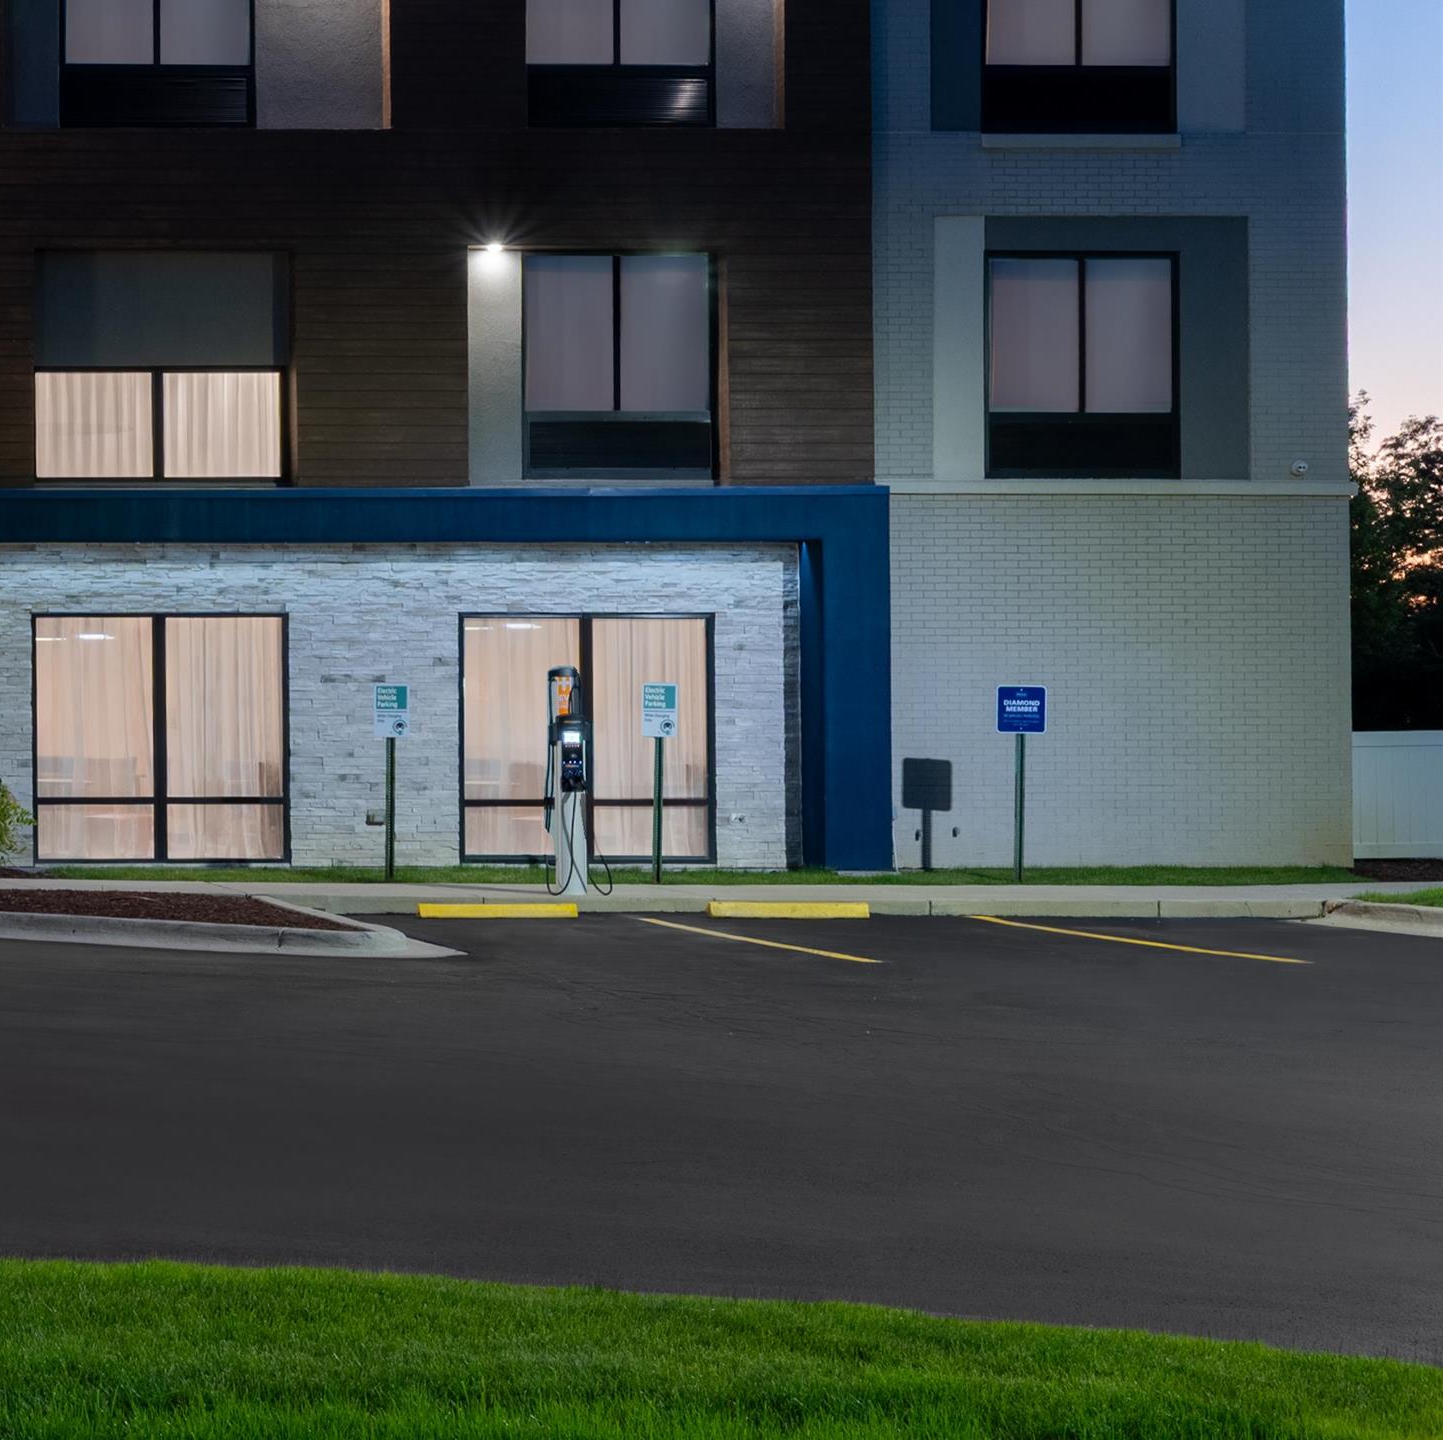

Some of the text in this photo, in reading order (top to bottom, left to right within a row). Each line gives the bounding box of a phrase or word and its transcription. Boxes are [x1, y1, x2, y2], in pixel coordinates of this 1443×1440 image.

[645, 686, 665, 694] Electric
[378, 701, 398, 709] Parking
[645, 701, 666, 709] Parking
